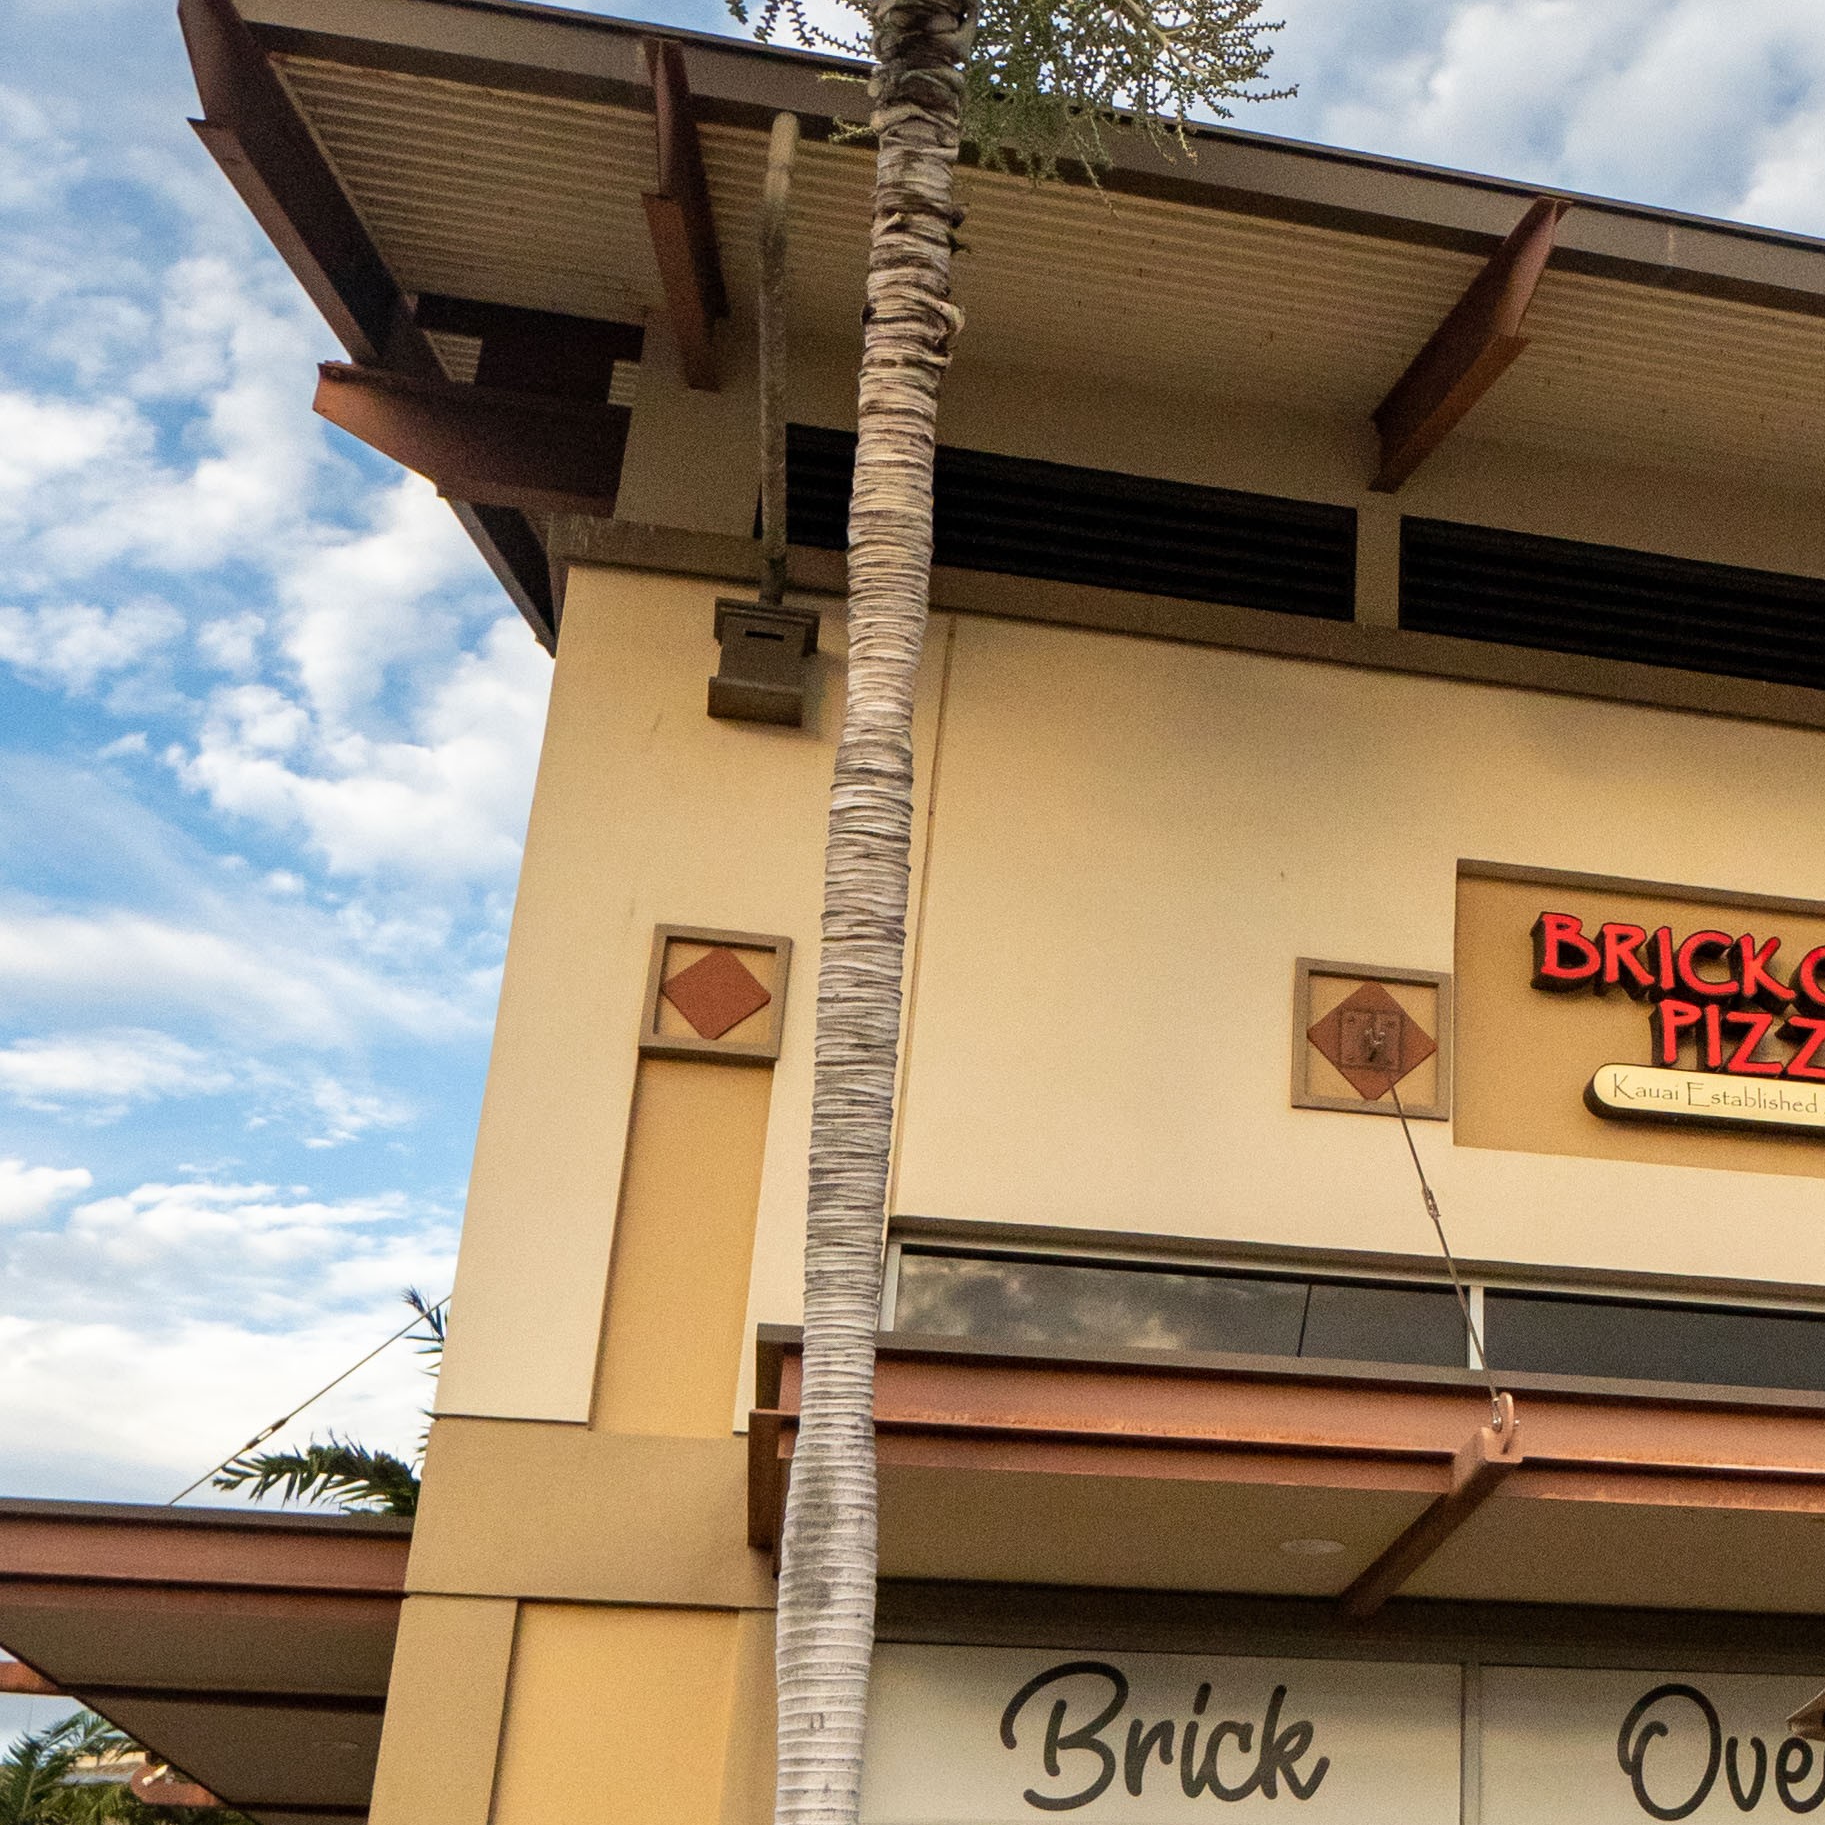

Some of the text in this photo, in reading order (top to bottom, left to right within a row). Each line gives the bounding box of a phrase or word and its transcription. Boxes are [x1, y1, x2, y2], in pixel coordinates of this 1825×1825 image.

[1534, 912, 1796, 1009] BRICK
[1613, 1073, 1679, 1101] Kauai
[1686, 1080, 1818, 1114] Established
[999, 1660, 1331, 1812] Brick
